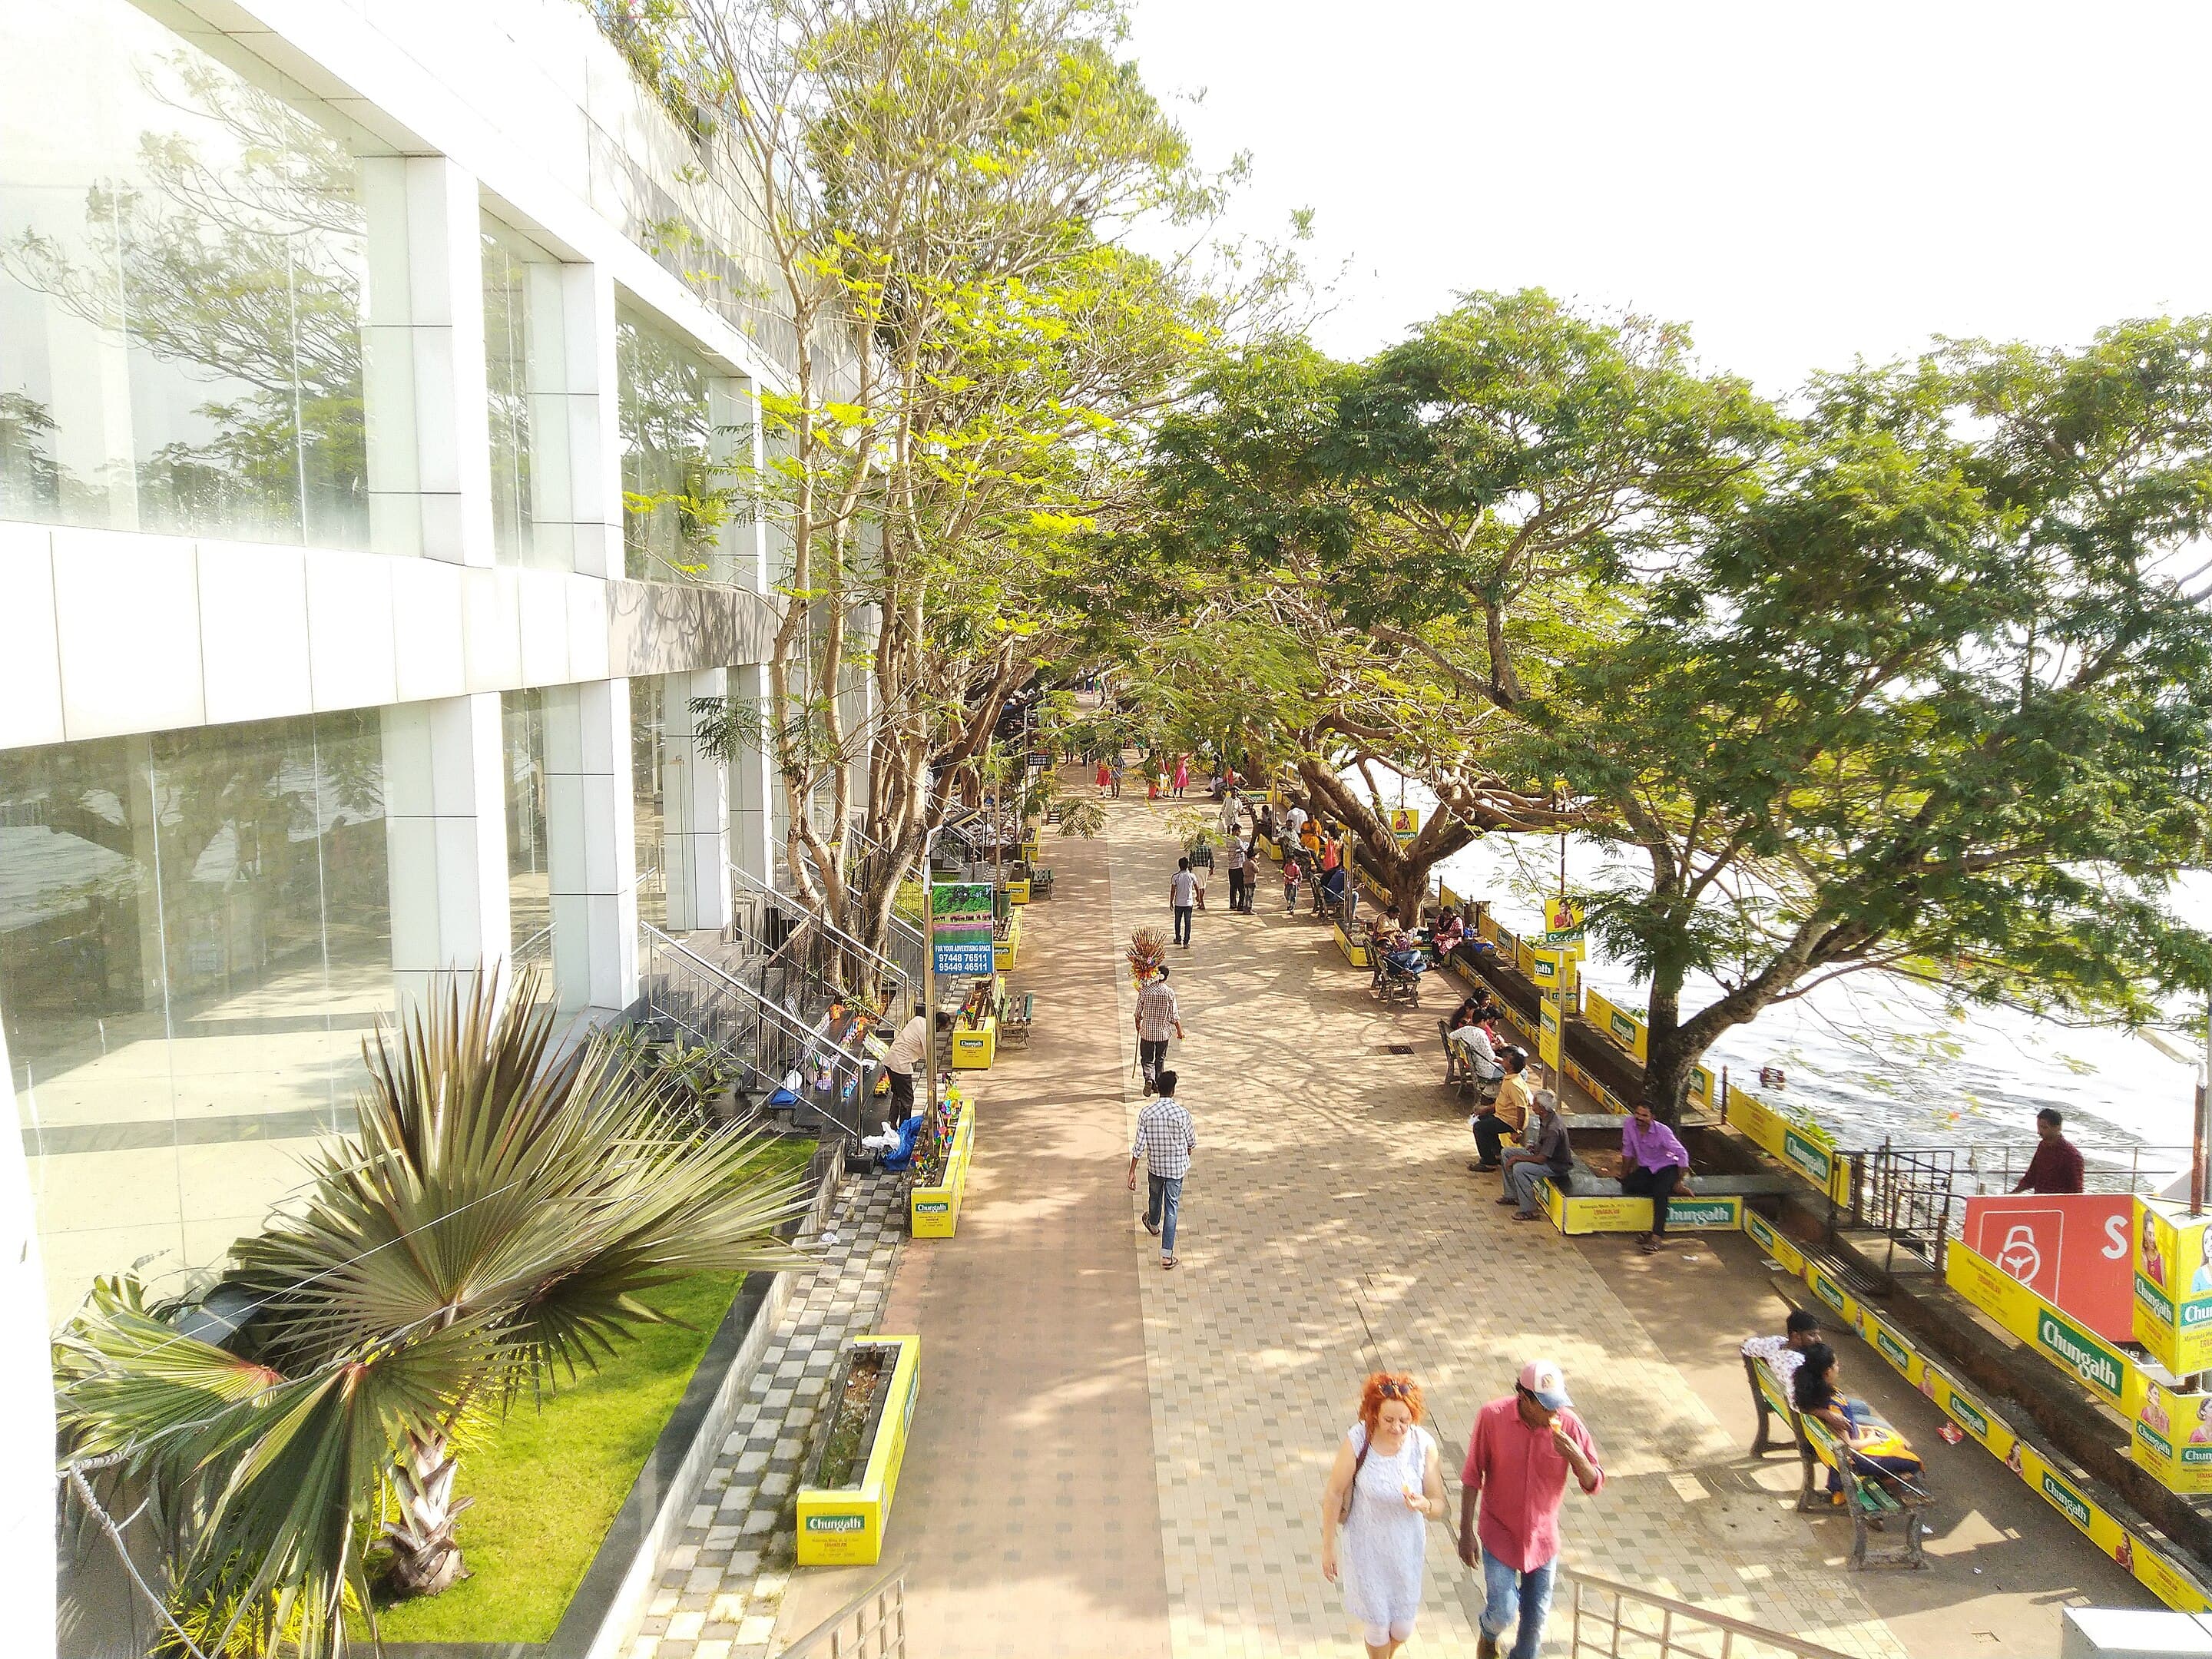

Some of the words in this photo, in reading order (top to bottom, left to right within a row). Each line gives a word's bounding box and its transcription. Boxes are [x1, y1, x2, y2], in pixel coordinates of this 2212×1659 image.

[939, 953, 962, 962] 97448
[964, 953, 987, 962] 76511
[939, 962, 962, 971] 95449
[964, 962, 988, 971] 46511
[917, 1204, 946, 1213] Chungath
[1666, 1206, 1728, 1225] hungath
[2101, 1215, 2128, 1260] S
[2136, 1277, 2172, 1323] Chungath
[2044, 1320, 2116, 1389] Chungath
[2138, 1424, 2171, 1456] Chungath
[2185, 1450, 2212, 1462] Chun
[2045, 1478, 2087, 1523] Chungath
[810, 1516, 861, 1533] Chungath
